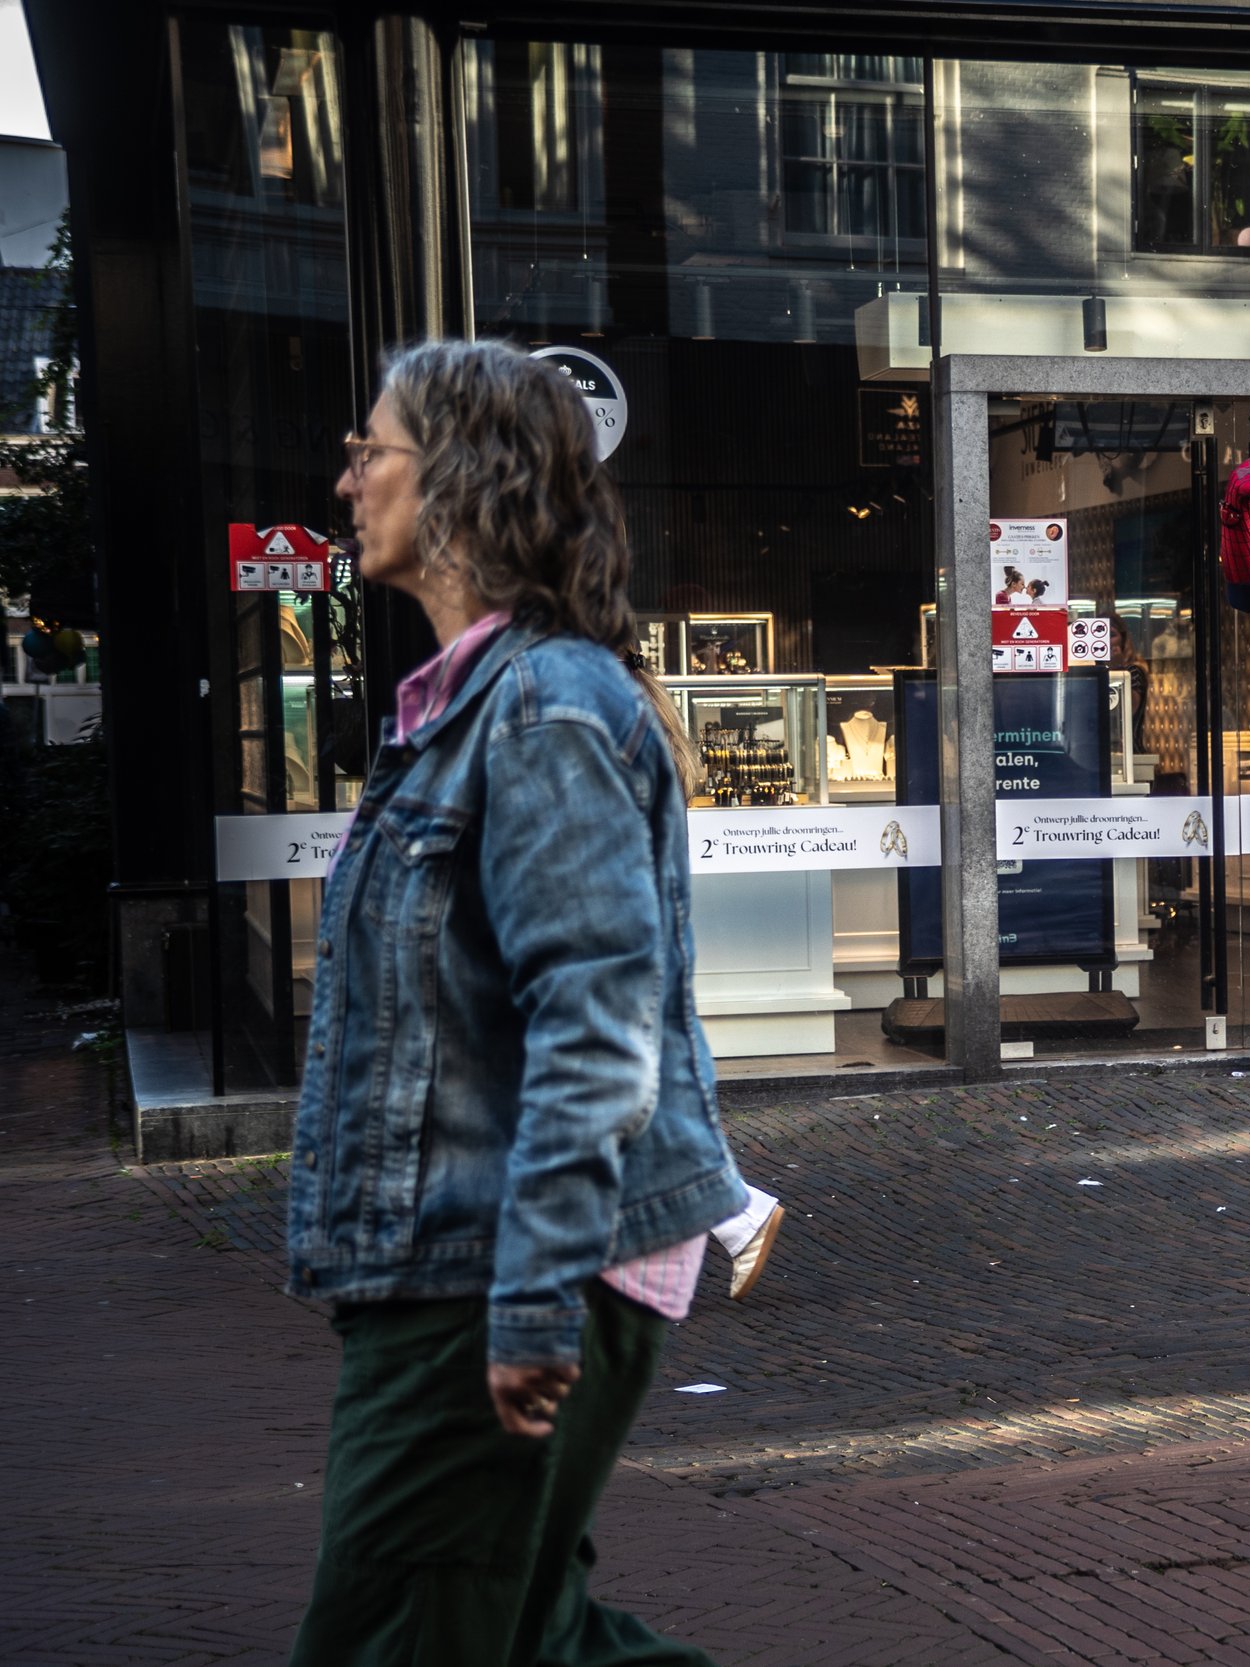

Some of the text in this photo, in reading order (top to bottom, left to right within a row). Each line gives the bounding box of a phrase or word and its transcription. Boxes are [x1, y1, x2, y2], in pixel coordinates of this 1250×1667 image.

[572, 379, 596, 390] ALS
[996, 752, 1039, 767] alen,
[996, 777, 1040, 790] rente
[1034, 814, 1149, 825] Ontwerp jullie droomringen...
[723, 825, 844, 838] Ontwerp jullie droomringen...
[1033, 829, 1103, 845] Trouwring
[1106, 828, 1160, 841] Cadeau!
[723, 841, 797, 857] Trouwring
[801, 839, 857, 852] Cadeau!
